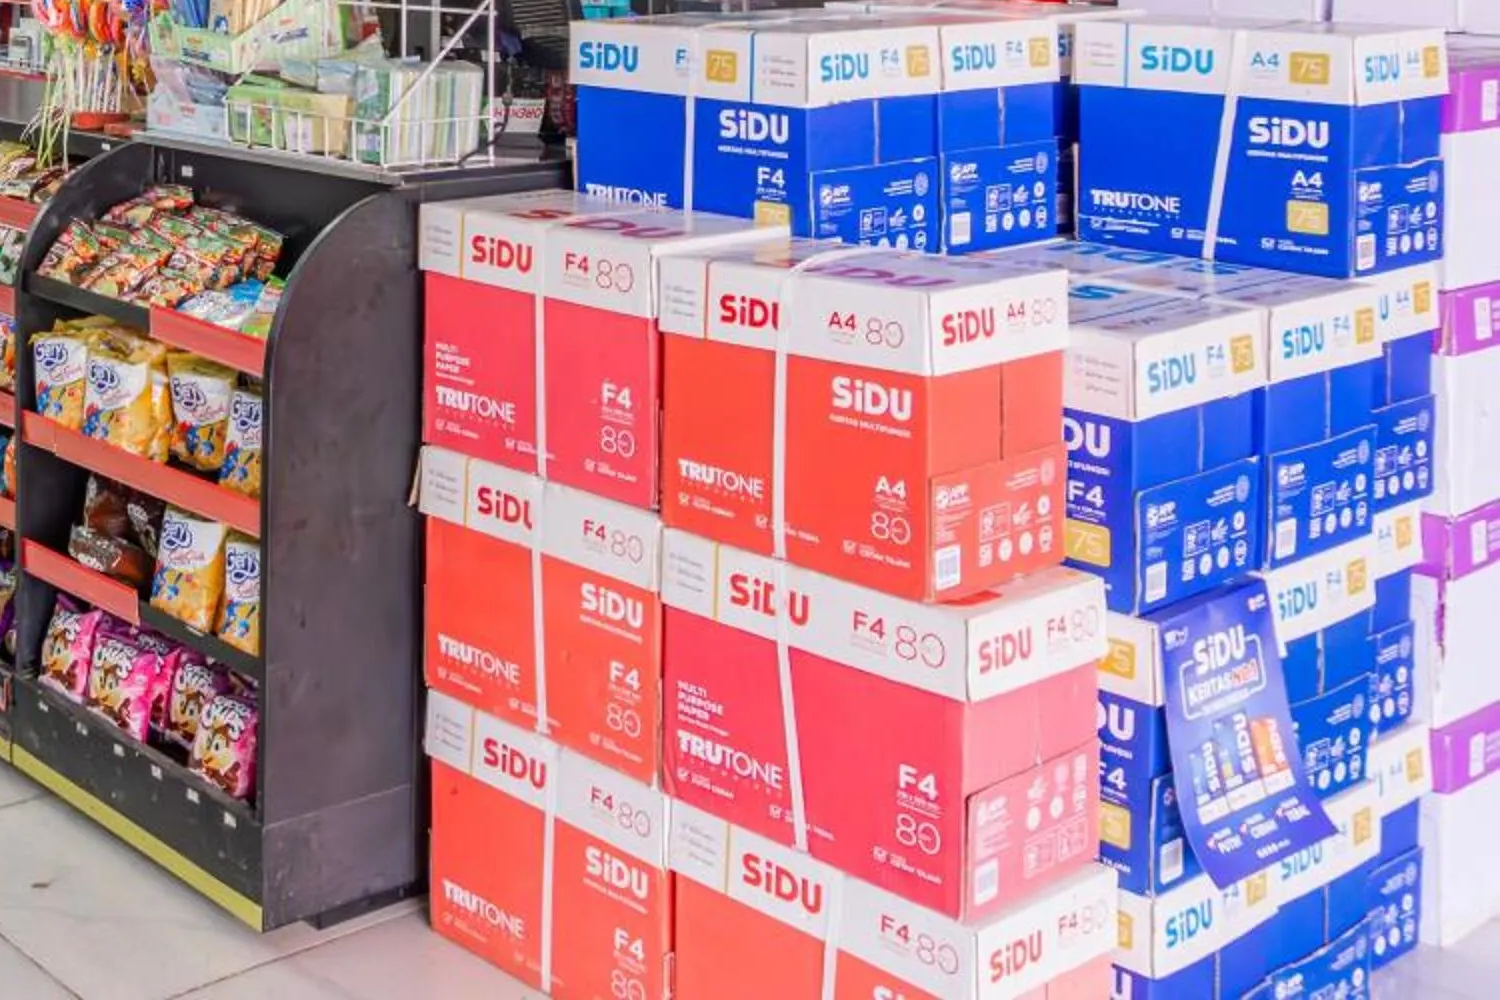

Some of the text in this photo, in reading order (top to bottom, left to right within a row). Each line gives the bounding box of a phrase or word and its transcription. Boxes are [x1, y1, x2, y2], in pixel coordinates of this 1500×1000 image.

[579, 42, 733, 79] SiDU F 75
[820, 53, 870, 82] SiDU
[880, 49, 899, 65] F4
[952, 44, 996, 72] SiDU
[1006, 41, 1023, 56] F4
[1141, 45, 1323, 78] SiDU A4 75
[1365, 55, 1400, 83] SiDU
[719, 109, 789, 144] SiDU
[1248, 117, 1330, 149] SiDU
[757, 166, 785, 187] F4
[1292, 170, 1323, 188] A4
[1091, 189, 1181, 214] TRUTONE
[1297, 208, 1323, 229] 75
[471, 234, 533, 274] SiDU
[565, 253, 590, 273] F4
[596, 259, 634, 293] 80
[719, 293, 779, 332] SiD
[828, 311, 857, 331] A4
[941, 306, 996, 347] SiDU
[1006, 302, 1026, 320] A4
[1283, 323, 1325, 359] SiDU
[1147, 354, 1196, 394] SiDU
[1207, 342, 1225, 365] F4
[435, 386, 516, 425] TRUTONE
[602, 382, 632, 409] F4
[831, 375, 913, 422] SiDU
[601, 426, 636, 458] 80
[678, 458, 765, 497] TRUTONE
[875, 475, 907, 500] A4
[1068, 481, 1105, 508] F4
[477, 486, 644, 564] SiD F4 80
[870, 511, 911, 545] 80
[1076, 528, 1100, 554] 75
[579, 582, 644, 630] SiDU
[1277, 581, 1318, 621] iDU
[852, 610, 885, 640] F4
[895, 625, 945, 669] 80
[978, 627, 1033, 674] SiDU
[1046, 615, 1068, 639] F4
[1193, 624, 1246, 676] SiDU
[438, 633, 521, 686] TRUTONE
[609, 660, 642, 692] F4
[677, 680, 708, 697] MULTI
[677, 691, 725, 716] PURPOSE
[606, 703, 642, 738] 80
[677, 702, 711, 721] PAPER
[677, 729, 784, 790] TRUTONE
[1232, 713, 1256, 774] SiDU
[483, 738, 651, 838] SiDU F4 80
[899, 763, 938, 801] F4
[895, 812, 941, 856] 80
[585, 846, 648, 900] SiDU
[442, 879, 525, 940] TRUTONE
[742, 852, 822, 915] SiDU
[879, 913, 911, 945] F4
[917, 932, 959, 977] 80
[1165, 899, 1213, 949] SiDU
[613, 927, 645, 960] F4
[989, 929, 1043, 984] SiDU
[1057, 912, 1079, 938] F4
